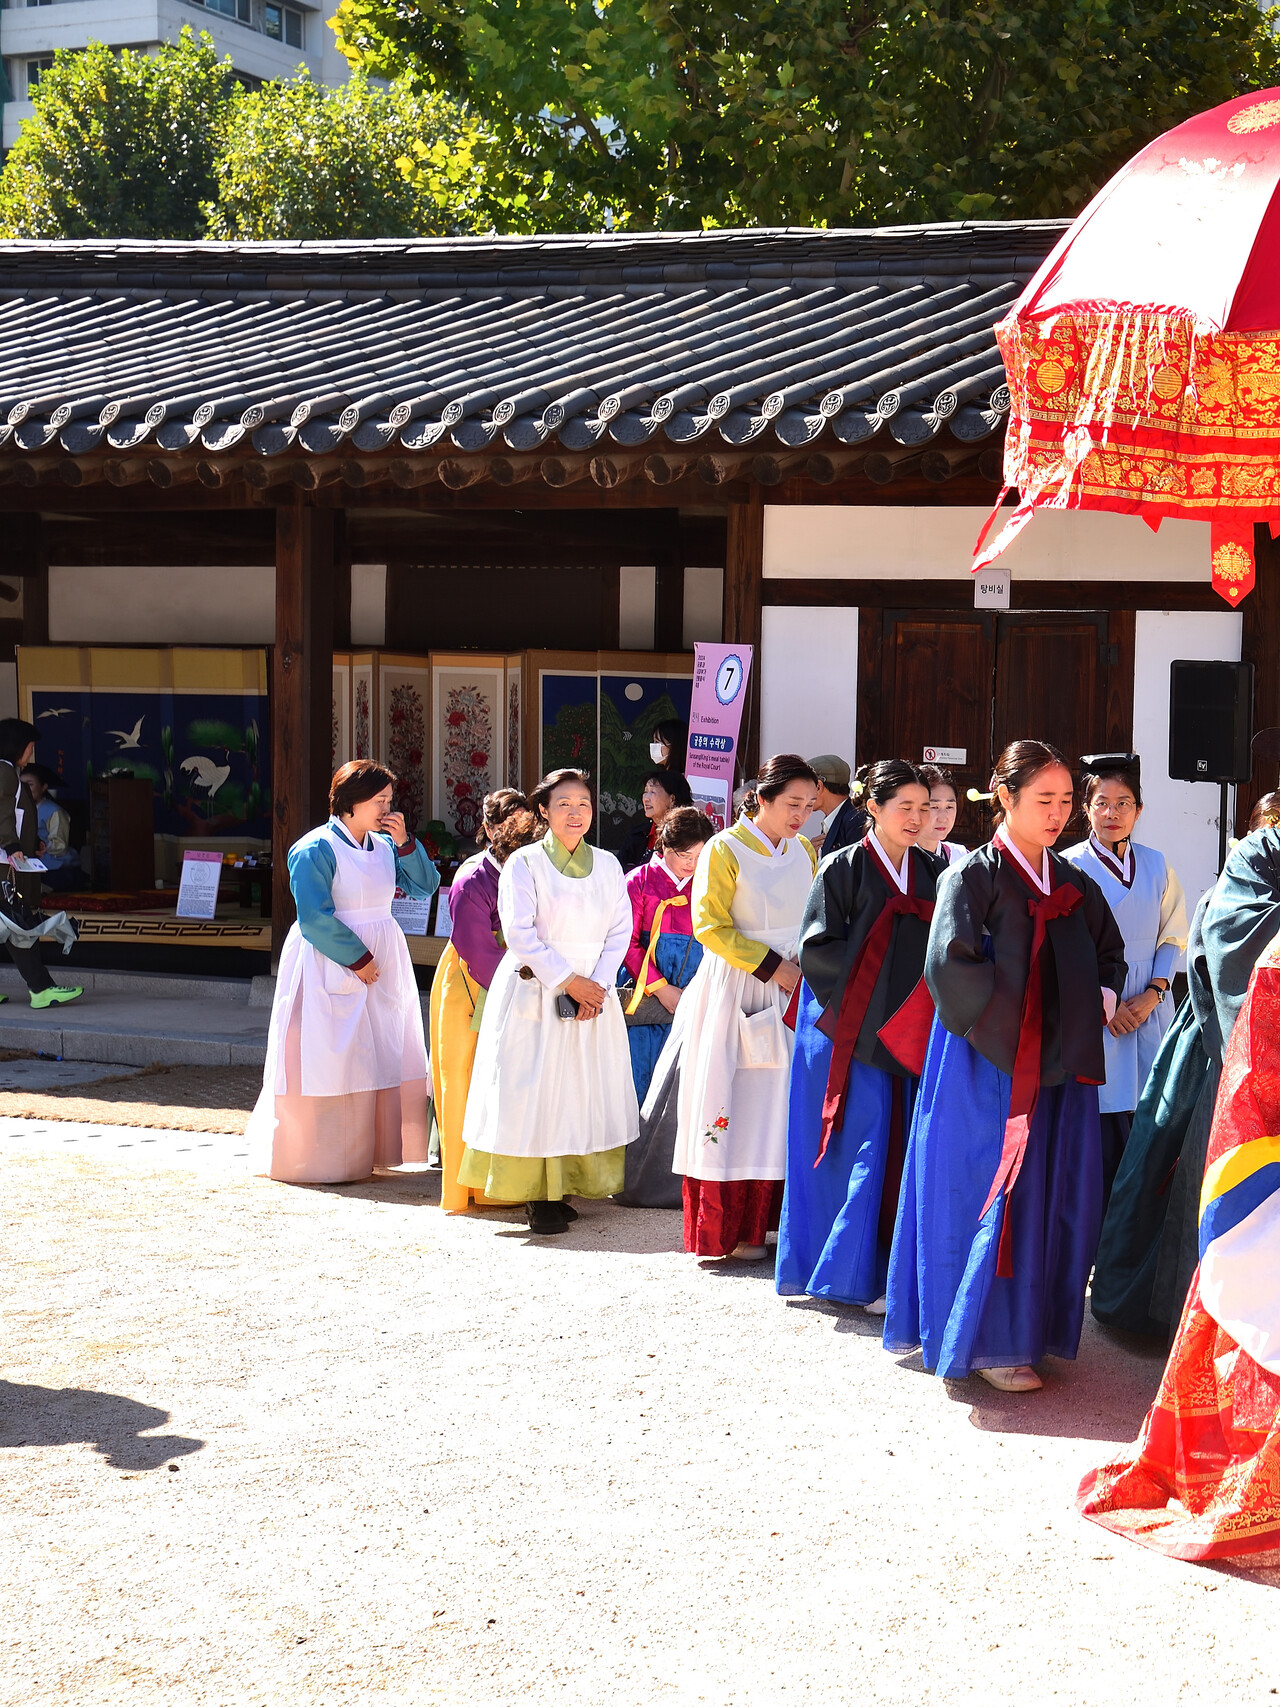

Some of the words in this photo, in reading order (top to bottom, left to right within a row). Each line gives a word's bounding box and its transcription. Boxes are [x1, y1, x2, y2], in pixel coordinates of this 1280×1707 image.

[981, 584, 1004, 594] 탕비실
[724, 667, 735, 691] 7
[700, 715, 719, 724] Exhibition
[694, 735, 708, 748] 궁중의
